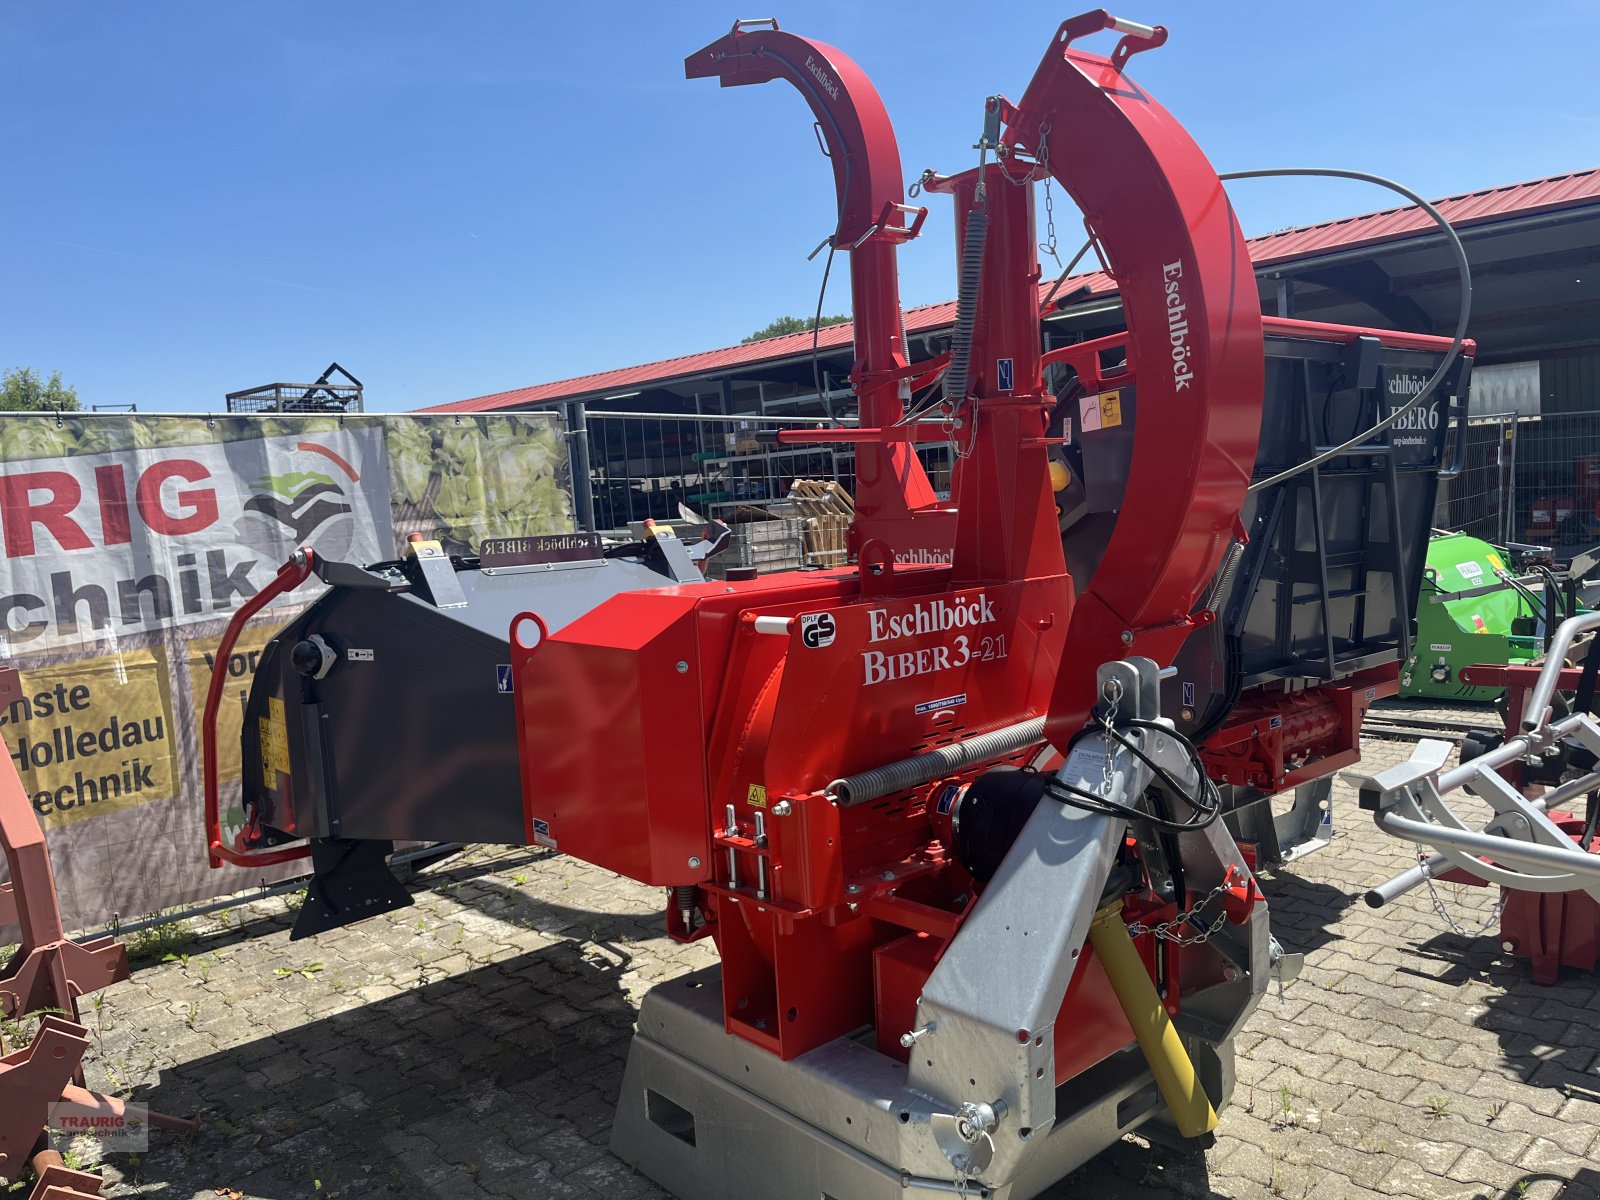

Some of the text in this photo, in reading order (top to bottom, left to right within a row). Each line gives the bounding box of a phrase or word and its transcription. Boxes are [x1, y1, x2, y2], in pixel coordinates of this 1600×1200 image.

[805, 55, 839, 100] Eschlböck
[1162, 258, 1194, 392] Eschlböck
[1377, 401, 1427, 430] IBER
[0, 459, 219, 558] RIG
[803, 613, 835, 648] GS
[867, 593, 997, 643] Eschlböck
[5, 715, 165, 772] Holledau
[27, 757, 156, 816] echnik
